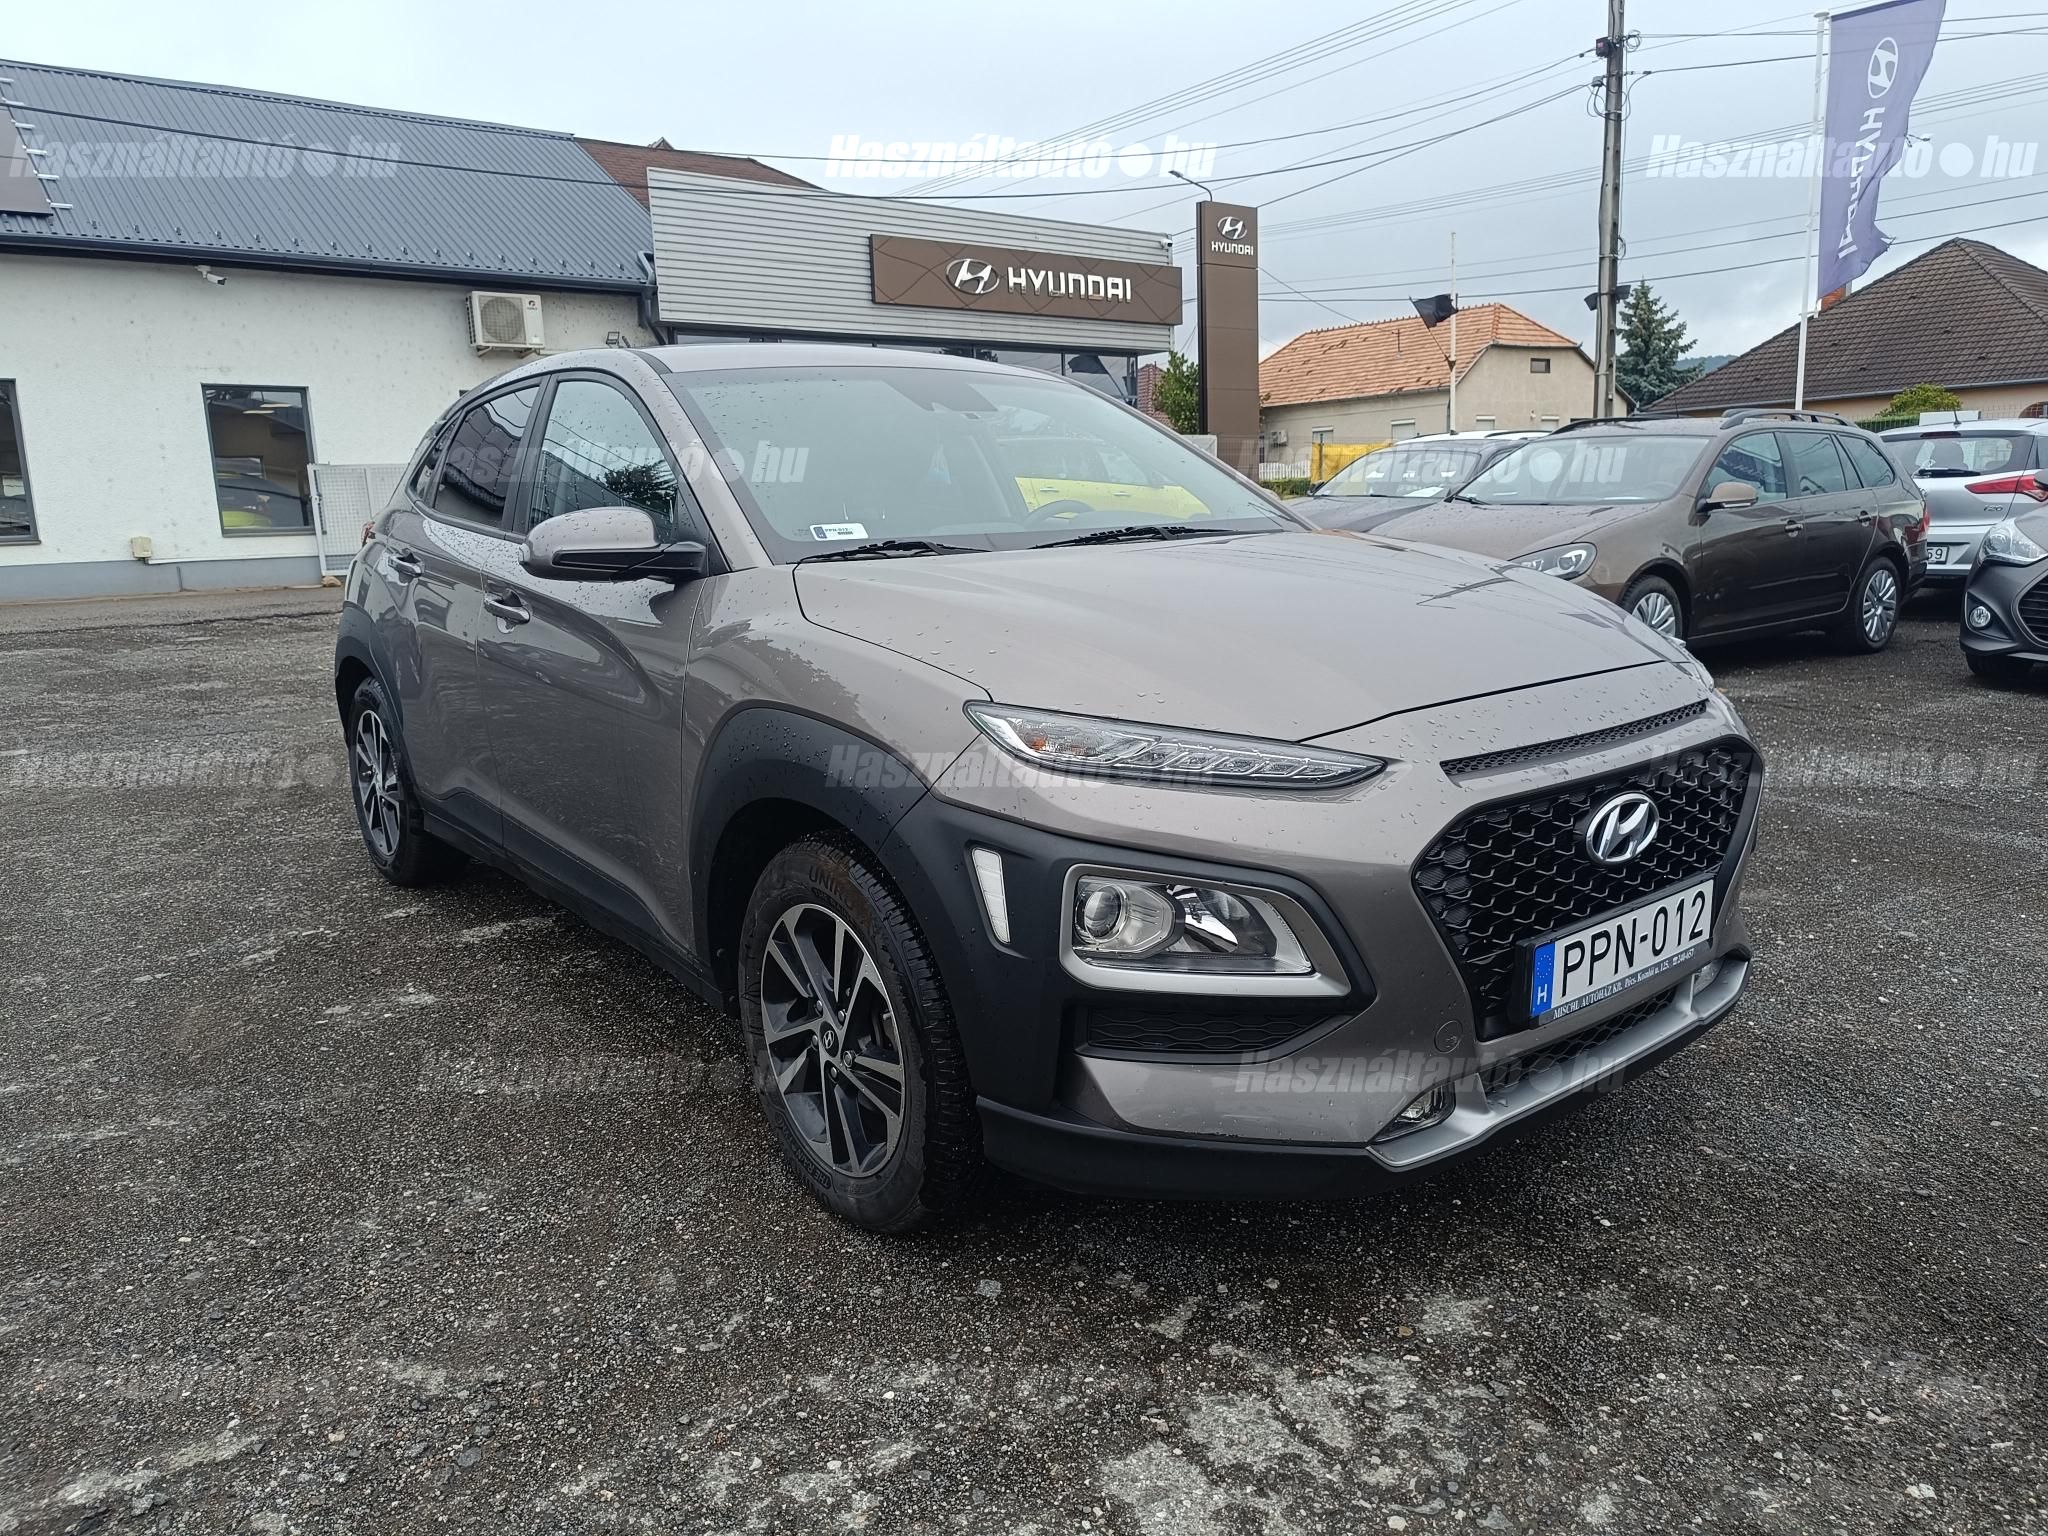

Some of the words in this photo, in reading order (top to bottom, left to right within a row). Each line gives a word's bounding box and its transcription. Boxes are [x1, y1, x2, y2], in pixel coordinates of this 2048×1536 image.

[1211, 241, 1254, 256] HYUNDAI
[1007, 266, 1132, 303] HYUNDAI
[1561, 890, 1706, 998] PPN-012
[1537, 984, 1548, 1006] H
